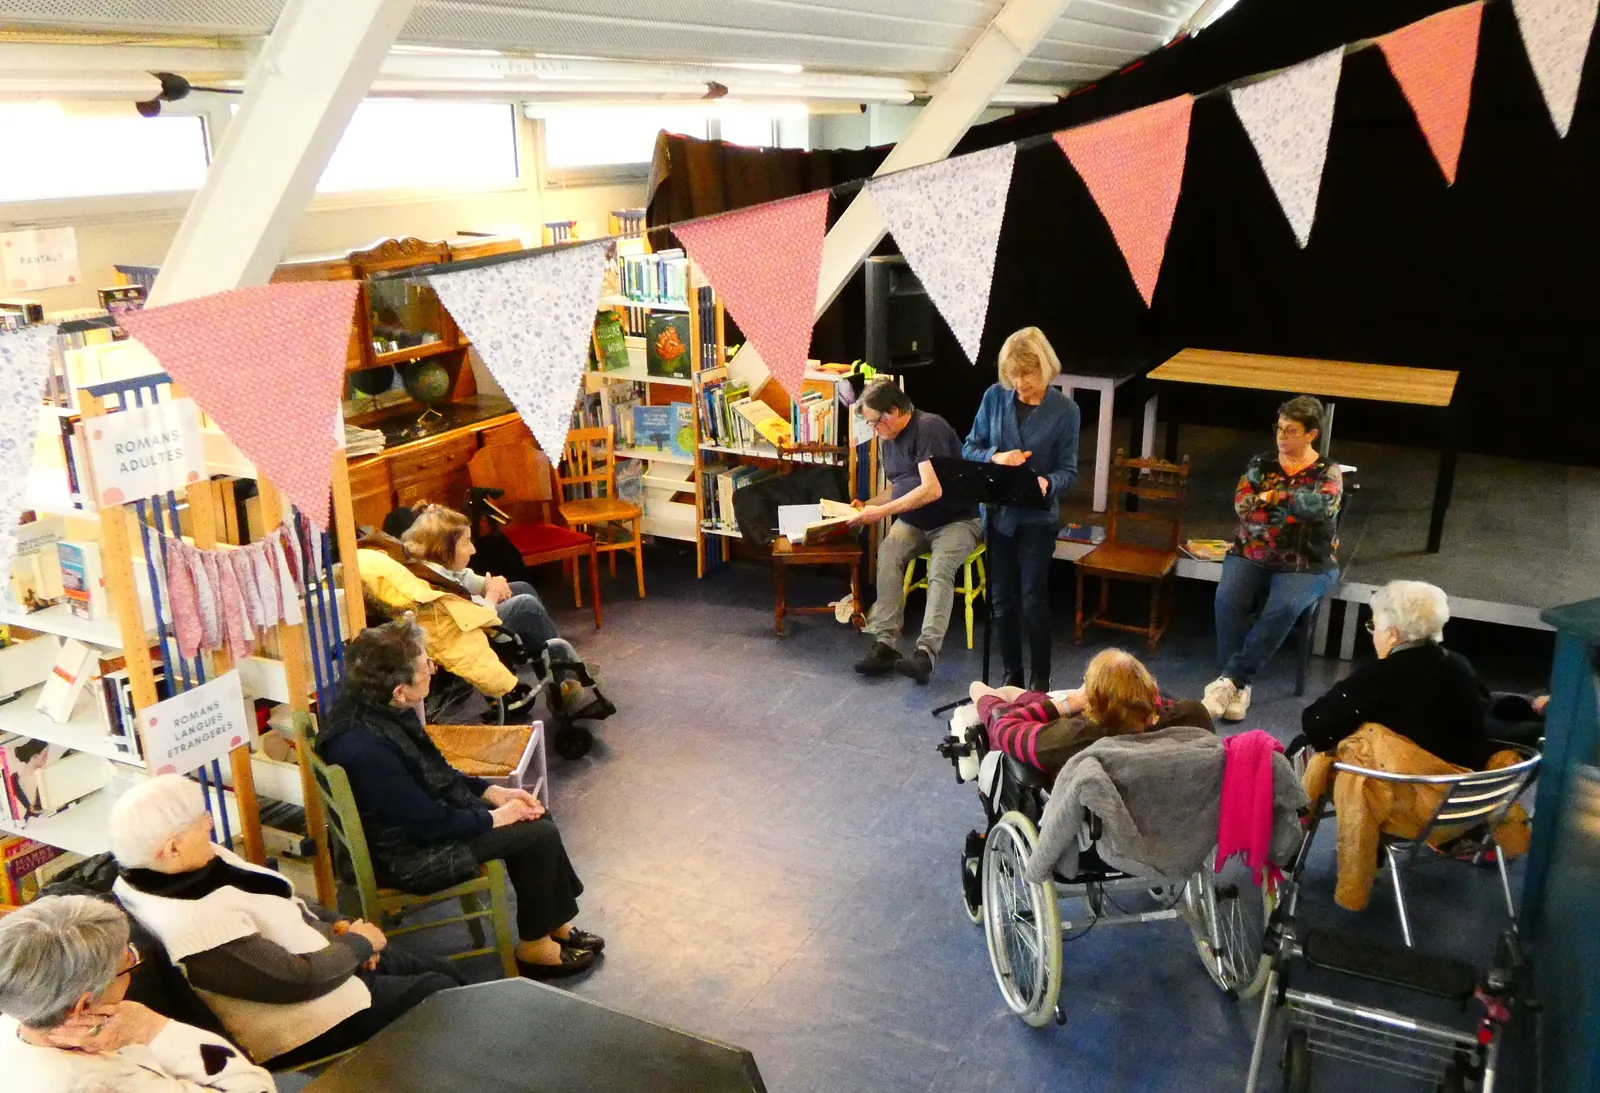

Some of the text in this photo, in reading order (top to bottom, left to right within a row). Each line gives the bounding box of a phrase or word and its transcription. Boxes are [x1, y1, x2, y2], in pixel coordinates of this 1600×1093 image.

[20, 252, 63, 265] FANTASY
[115, 430, 180, 455] ROMANS
[119, 447, 183, 475] ADULTES
[173, 700, 220, 728] ROMANS
[174, 712, 224, 742] LANGUES
[167, 721, 233, 759] ETRANGERES
